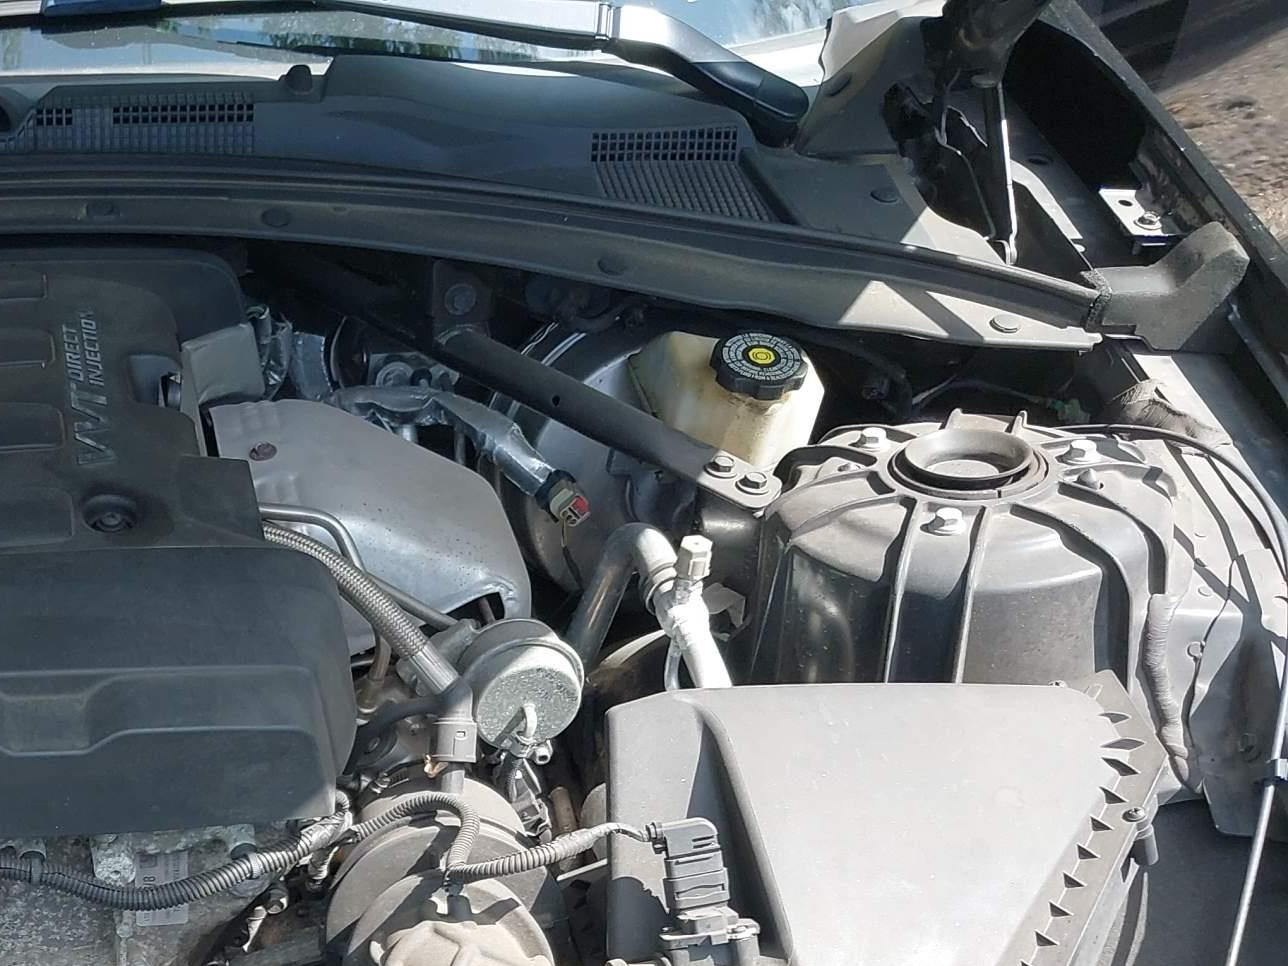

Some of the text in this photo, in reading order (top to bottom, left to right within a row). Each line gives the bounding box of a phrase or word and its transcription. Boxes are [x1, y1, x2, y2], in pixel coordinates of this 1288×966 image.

[62, 323, 84, 383] DIRECT
[77, 307, 106, 387] INJECTION
[70, 383, 116, 466] VVT
